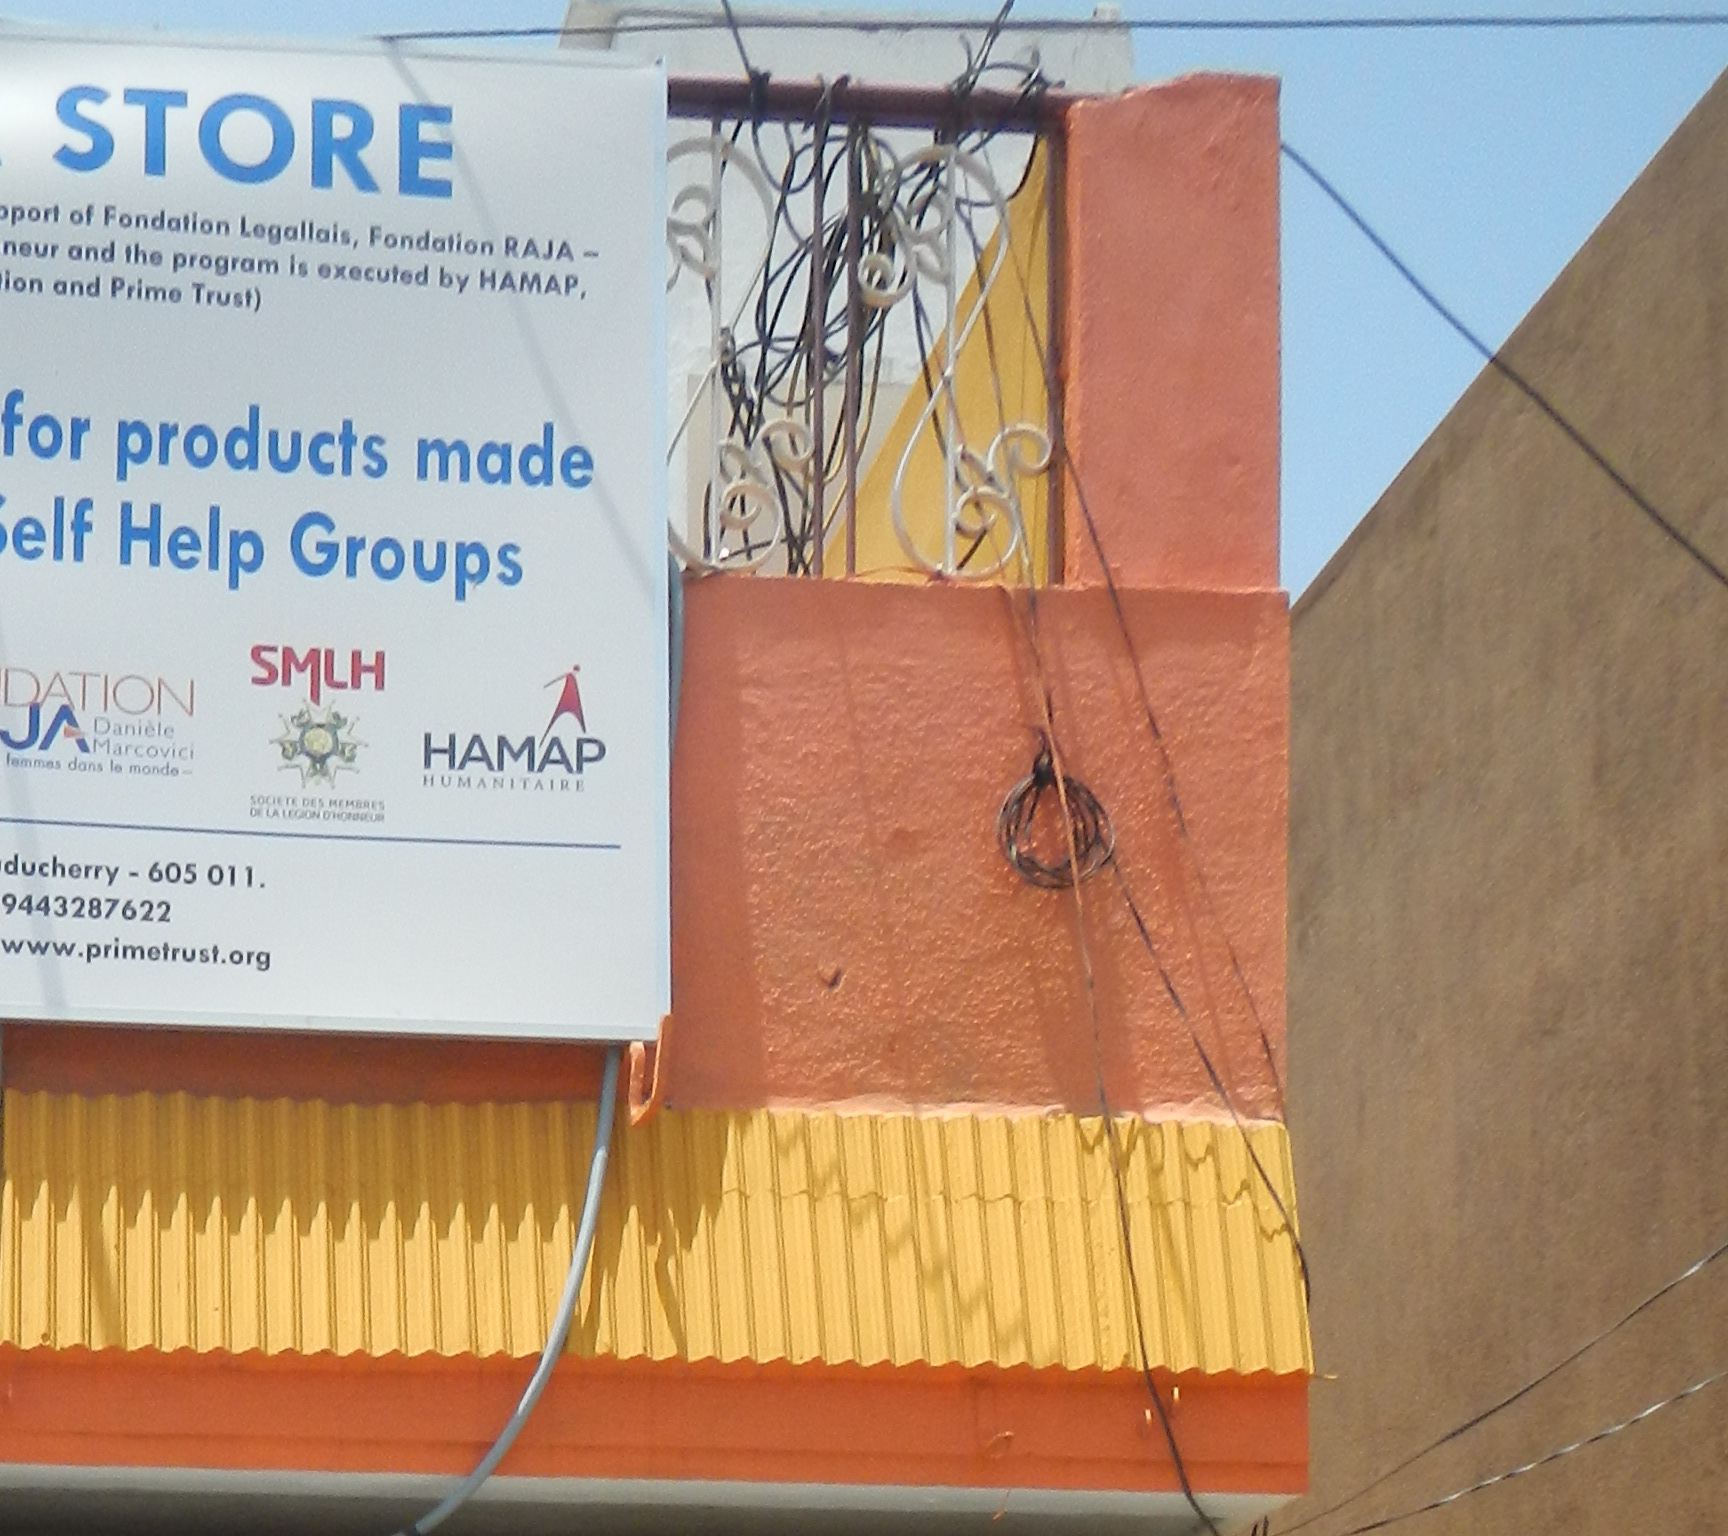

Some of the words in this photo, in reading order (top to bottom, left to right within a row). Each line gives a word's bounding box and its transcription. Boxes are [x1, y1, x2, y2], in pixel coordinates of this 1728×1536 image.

[53, 85, 454, 199] STORE
[70, 203, 94, 227] of
[104, 205, 230, 238] Fondation
[240, 215, 358, 250] Legallais,
[369, 225, 494, 256] Fondation
[503, 235, 575, 262] RAJA
[67, 238, 116, 264] and
[125, 238, 163, 268] the
[172, 248, 279, 277] program
[290, 252, 308, 278] is
[318, 263, 429, 287] executed
[439, 265, 469, 294] by
[480, 268, 586, 300] HAMAP,
[53, 273, 101, 298] and
[111, 275, 182, 303] Prime
[191, 281, 261, 313] Trust)
[1, 388, 91, 461] for
[116, 404, 388, 483] products
[417, 421, 594, 490] made
[120, 500, 264, 591] Help
[290, 511, 523, 603] Groups
[250, 644, 386, 706] SMLH
[93, 716, 175, 739] Danièle
[6, 754, 62, 771] femmes
[67, 758, 104, 773] dans
[92, 739, 195, 761] Marcovici
[423, 732, 607, 775] HAMAP
[422, 775, 586, 793] HUMANITAIRE
[148, 861, 197, 885] 605
[207, 864, 265, 888] 011.
[2, 892, 171, 923] 9443287622
[1, 937, 270, 972] www.primetrust.org
